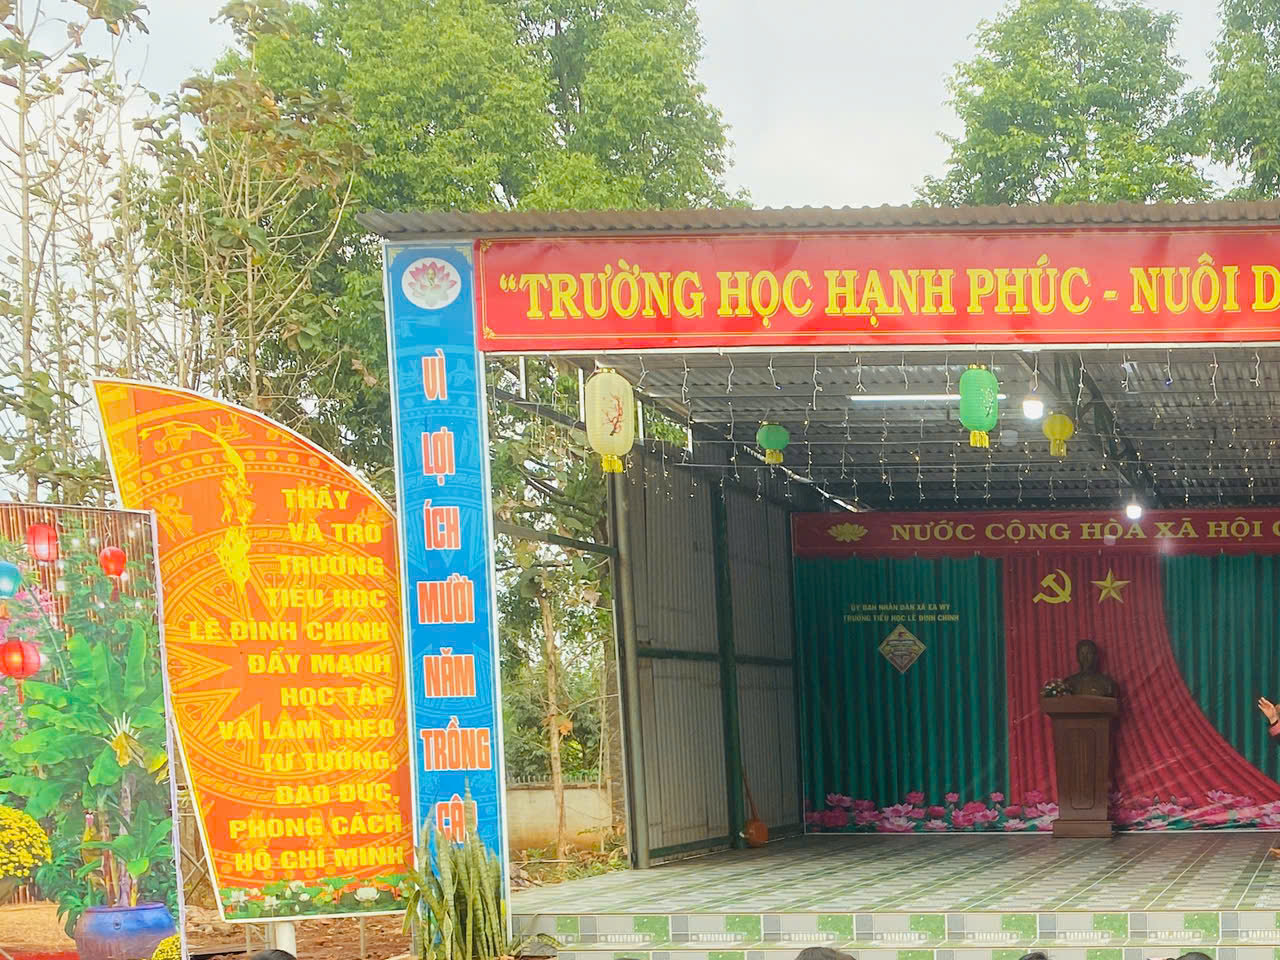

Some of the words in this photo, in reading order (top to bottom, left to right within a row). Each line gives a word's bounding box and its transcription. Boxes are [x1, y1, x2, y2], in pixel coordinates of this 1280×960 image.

[499, 258, 706, 320] “TRƯỜNG
[716, 268, 814, 328] HỌC
[823, 268, 956, 328] HẠNH
[966, 253, 1093, 315] PHÚC
[1129, 251, 1241, 314] NUÔI
[421, 426, 456, 486] LỢI
[281, 484, 350, 510] THẦY
[288, 519, 325, 543] VÀ
[331, 519, 383, 544] TRÒ
[424, 499, 462, 550] ÍCH
[890, 519, 977, 542] NƯỚC
[984, 518, 1072, 545] CỘNG
[1079, 517, 1148, 541] HÒA
[1153, 517, 1199, 539] XÃ
[1207, 516, 1264, 542] HỘI
[275, 551, 385, 577] TRƯỜNG
[264, 581, 324, 608] TIỂU
[333, 588, 387, 612] HỌC
[417, 573, 475, 625] MƯỜI
[189, 616, 222, 641] LÊ
[230, 617, 298, 641] ĐÌNH
[305, 621, 389, 641] CHINH
[247, 645, 301, 674] ĐẨY
[310, 654, 392, 678] MẠNH
[424, 647, 477, 698] NĂM
[281, 686, 336, 711] HỌC
[343, 682, 394, 711] TẬP
[217, 716, 256, 740] VÀ
[262, 713, 322, 740] LÀM
[330, 718, 396, 739] THEO
[420, 716, 493, 771] TRỒNG
[260, 751, 295, 773] TƯ
[275, 784, 330, 809] ĐẠO
[228, 816, 323, 840] PHONG
[330, 811, 403, 836] CÁCH
[436, 793, 478, 844] CÂ
[234, 844, 272, 873] HỒ
[280, 845, 326, 870] CHÍ
[334, 845, 405, 868] MINH
